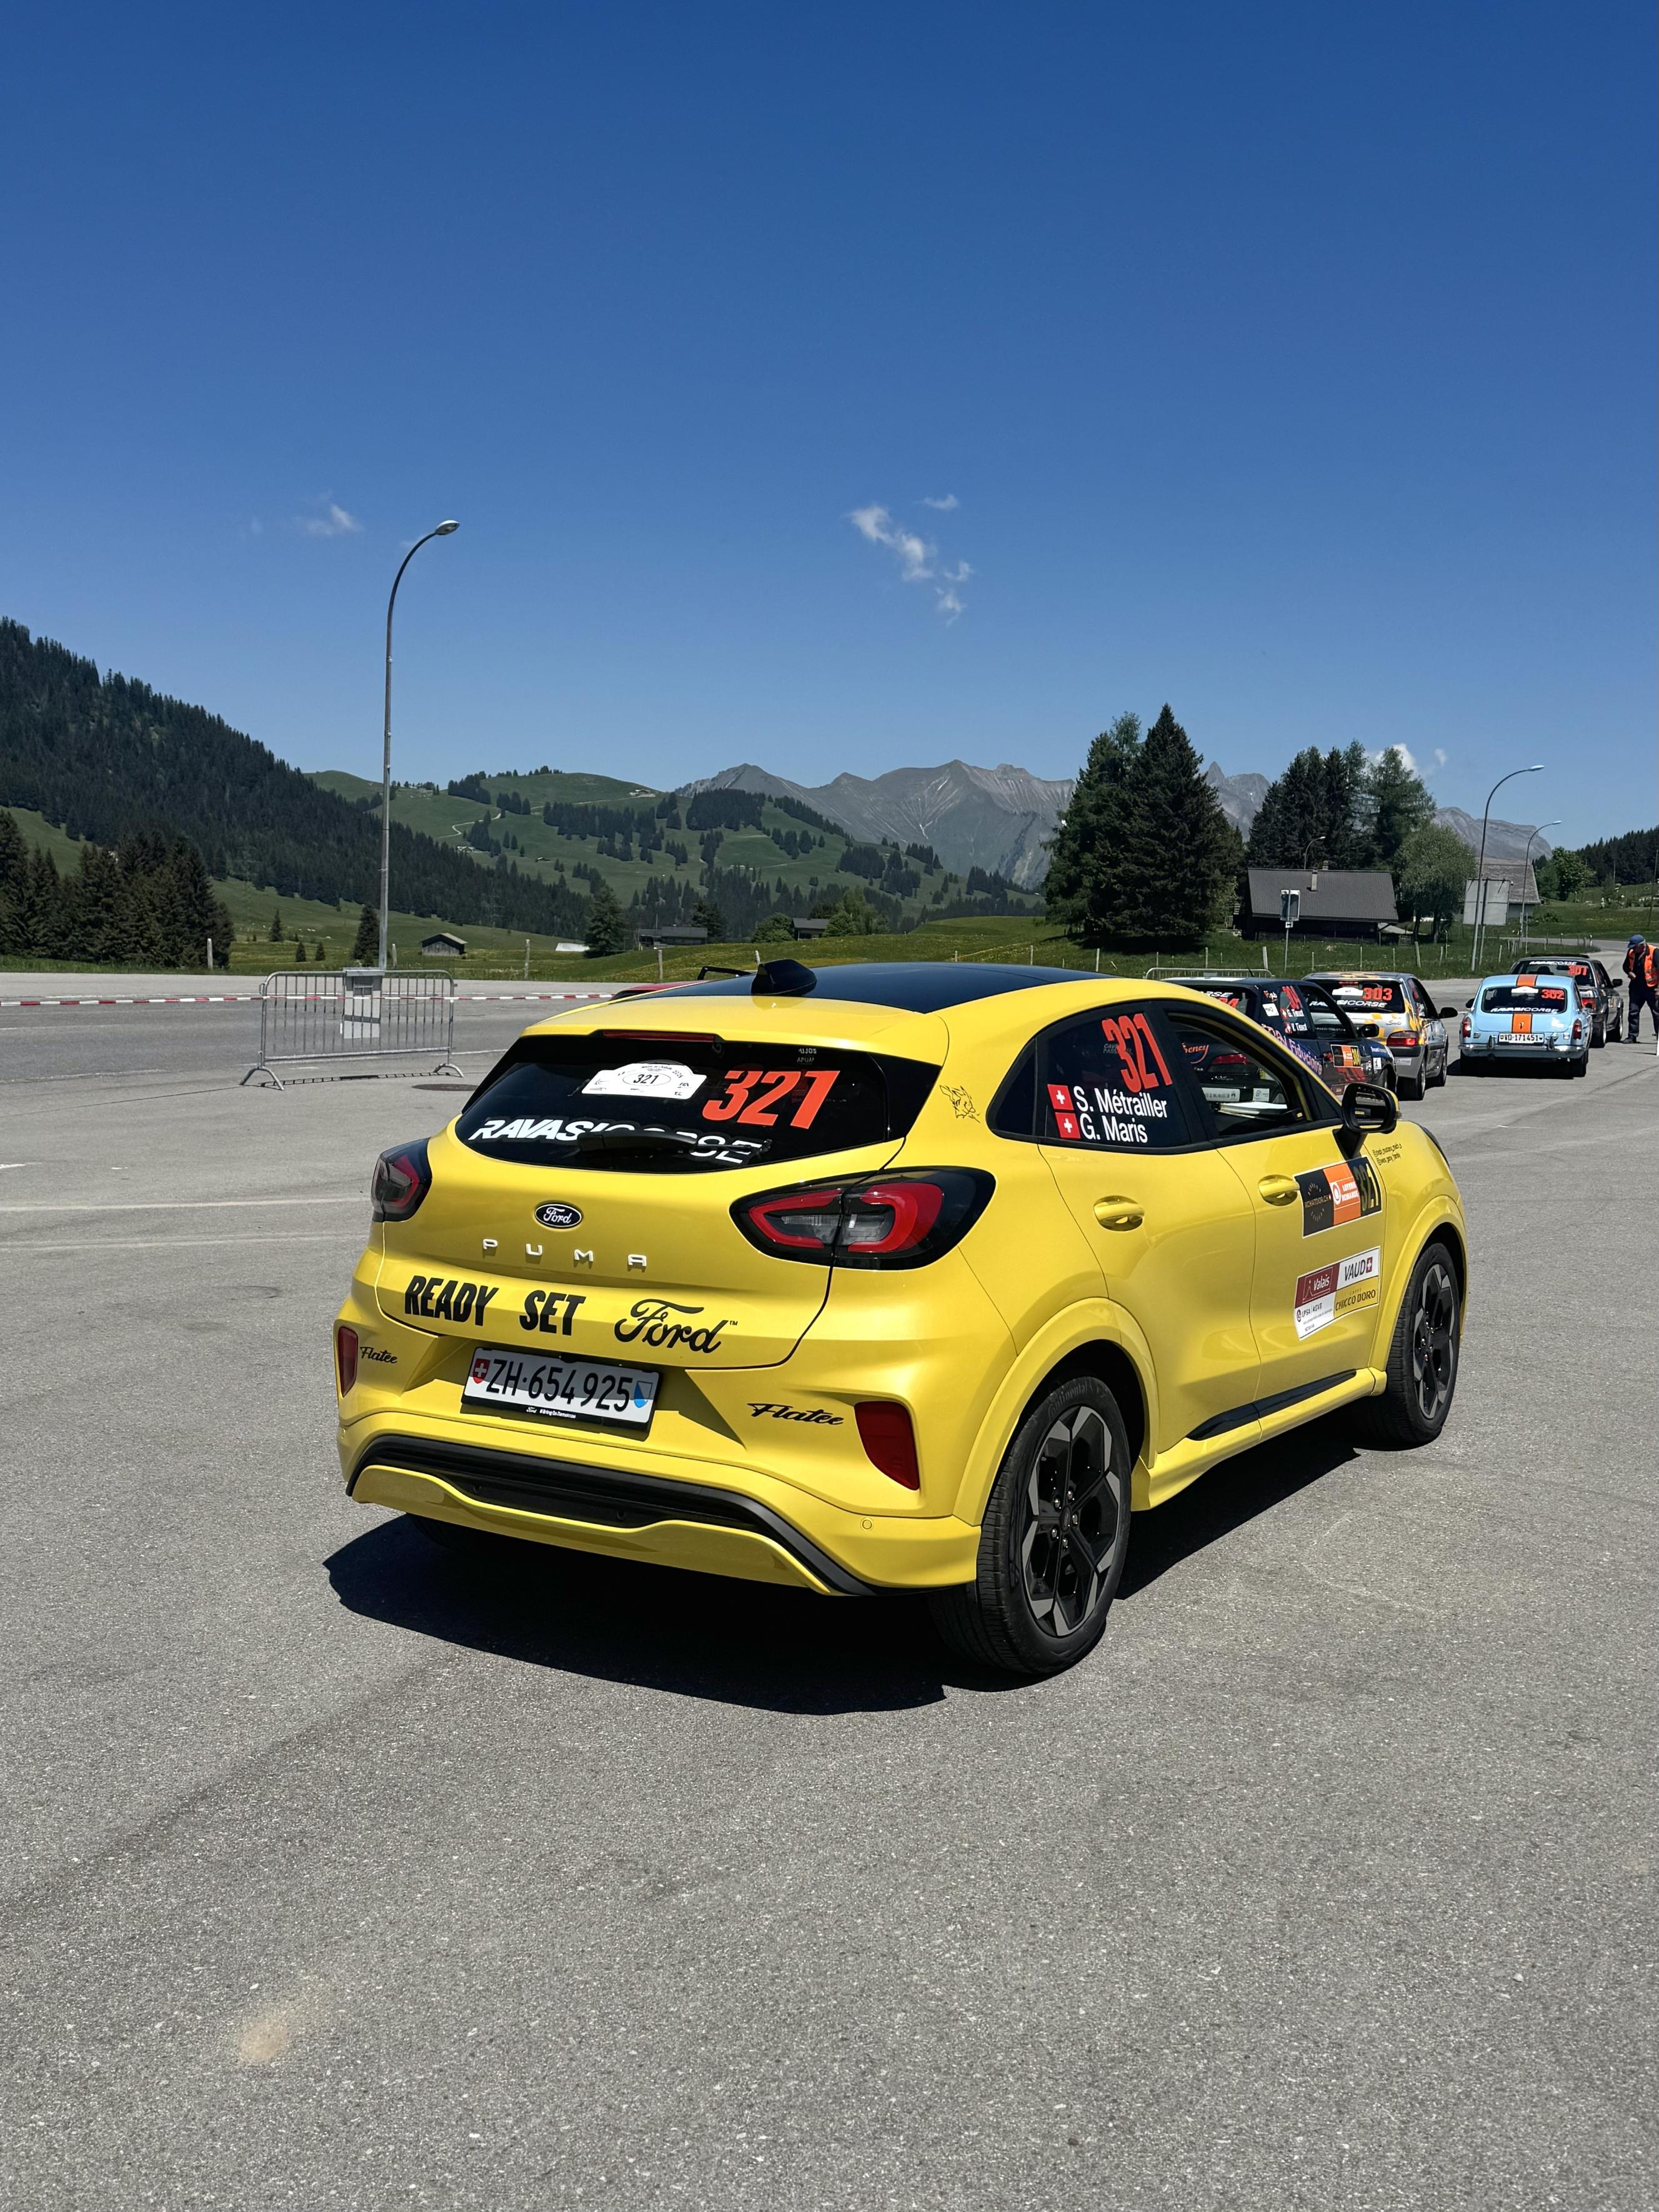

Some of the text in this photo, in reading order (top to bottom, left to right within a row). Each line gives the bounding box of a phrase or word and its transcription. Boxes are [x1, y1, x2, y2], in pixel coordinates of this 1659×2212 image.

[1363, 987, 1392, 1001] 303
[1541, 989, 1565, 1000] 302
[1102, 1013, 1173, 1093] 321
[633, 1074, 659, 1084] 321
[702, 1070, 840, 1128] 321
[1074, 1086, 1167, 1118] S. Métrailler
[1080, 1113, 1148, 1143] G. Maris
[1352, 1163, 1379, 1212] 321
[543, 1207, 572, 1223] Ford
[482, 1238, 647, 1267] PUMA
[1313, 1273, 1330, 1292] Valais
[1345, 1259, 1366, 1281] VAUD
[405, 1275, 499, 1326] READY
[519, 1290, 587, 1336] SET
[747, 1403, 844, 1425] Flatee
